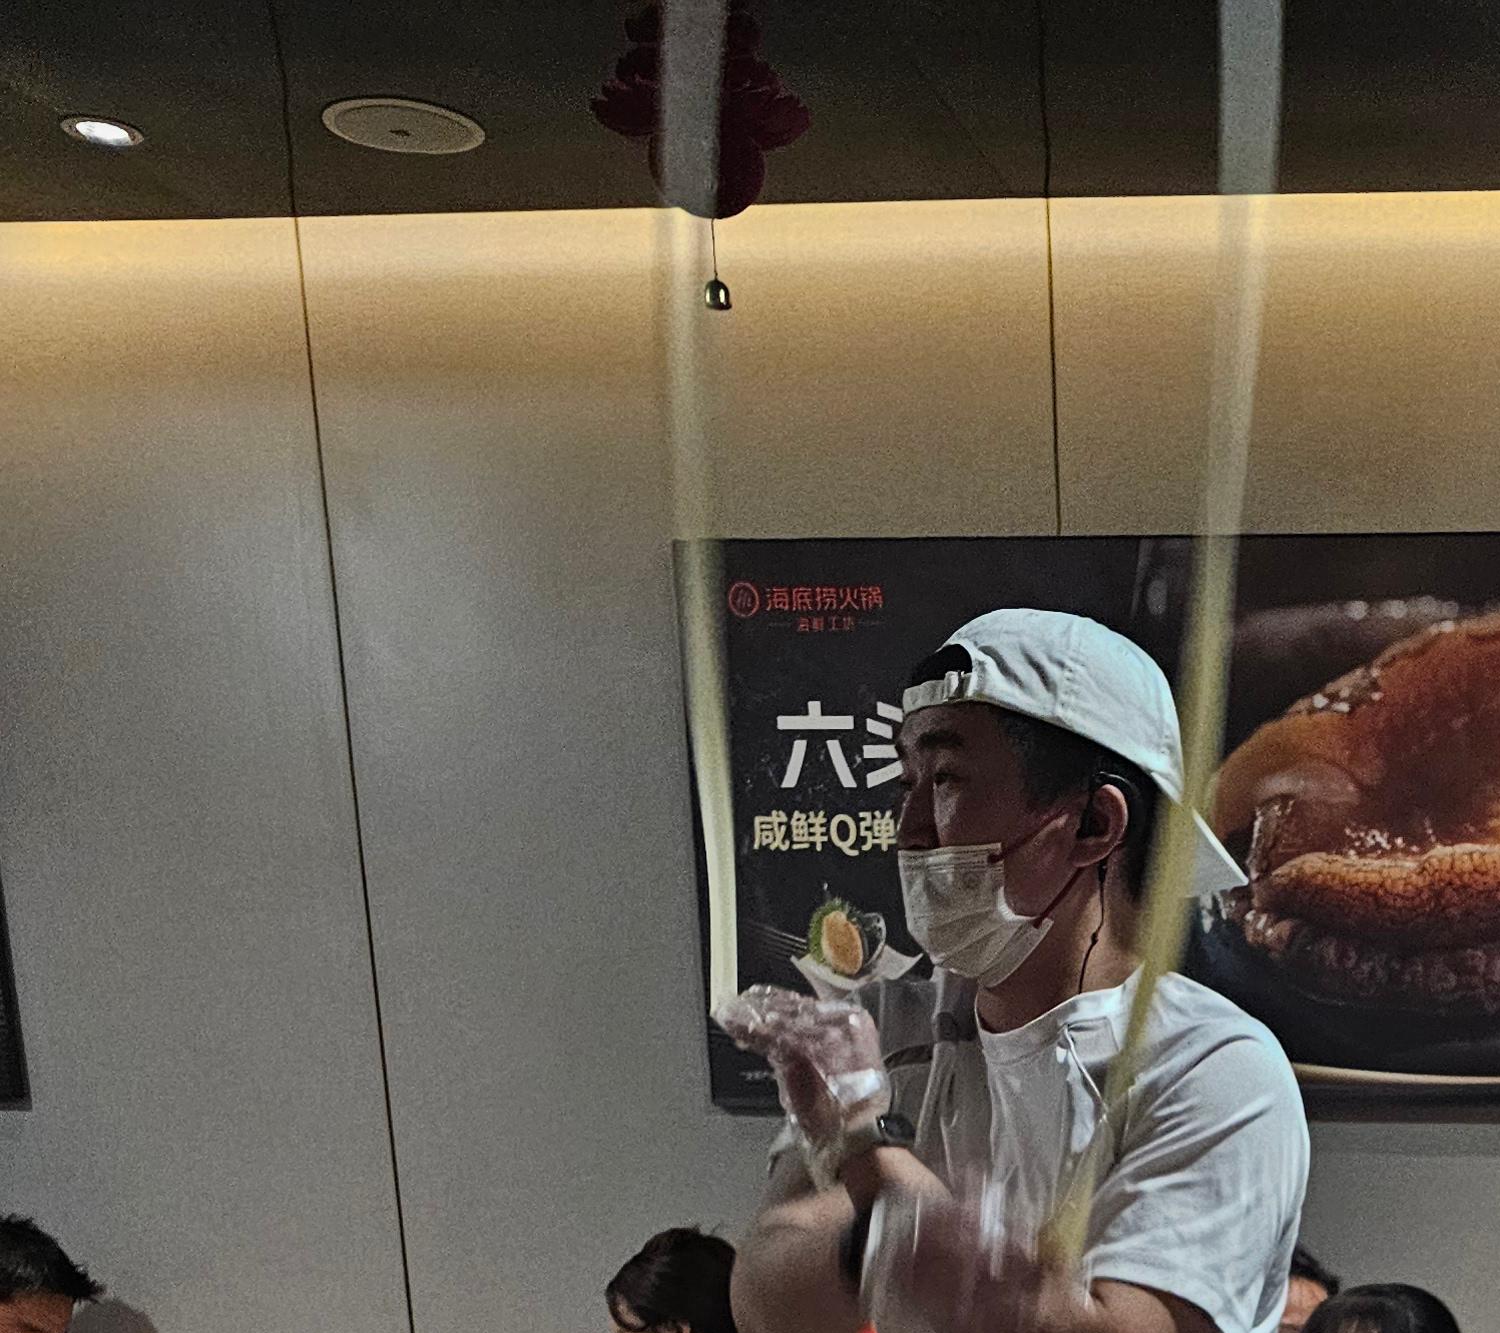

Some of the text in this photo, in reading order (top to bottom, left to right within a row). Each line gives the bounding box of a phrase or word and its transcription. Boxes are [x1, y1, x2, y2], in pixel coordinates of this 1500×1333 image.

[766, 585, 884, 612] 海底捞火锅
[753, 809, 897, 856] 咸鲜Q弹
